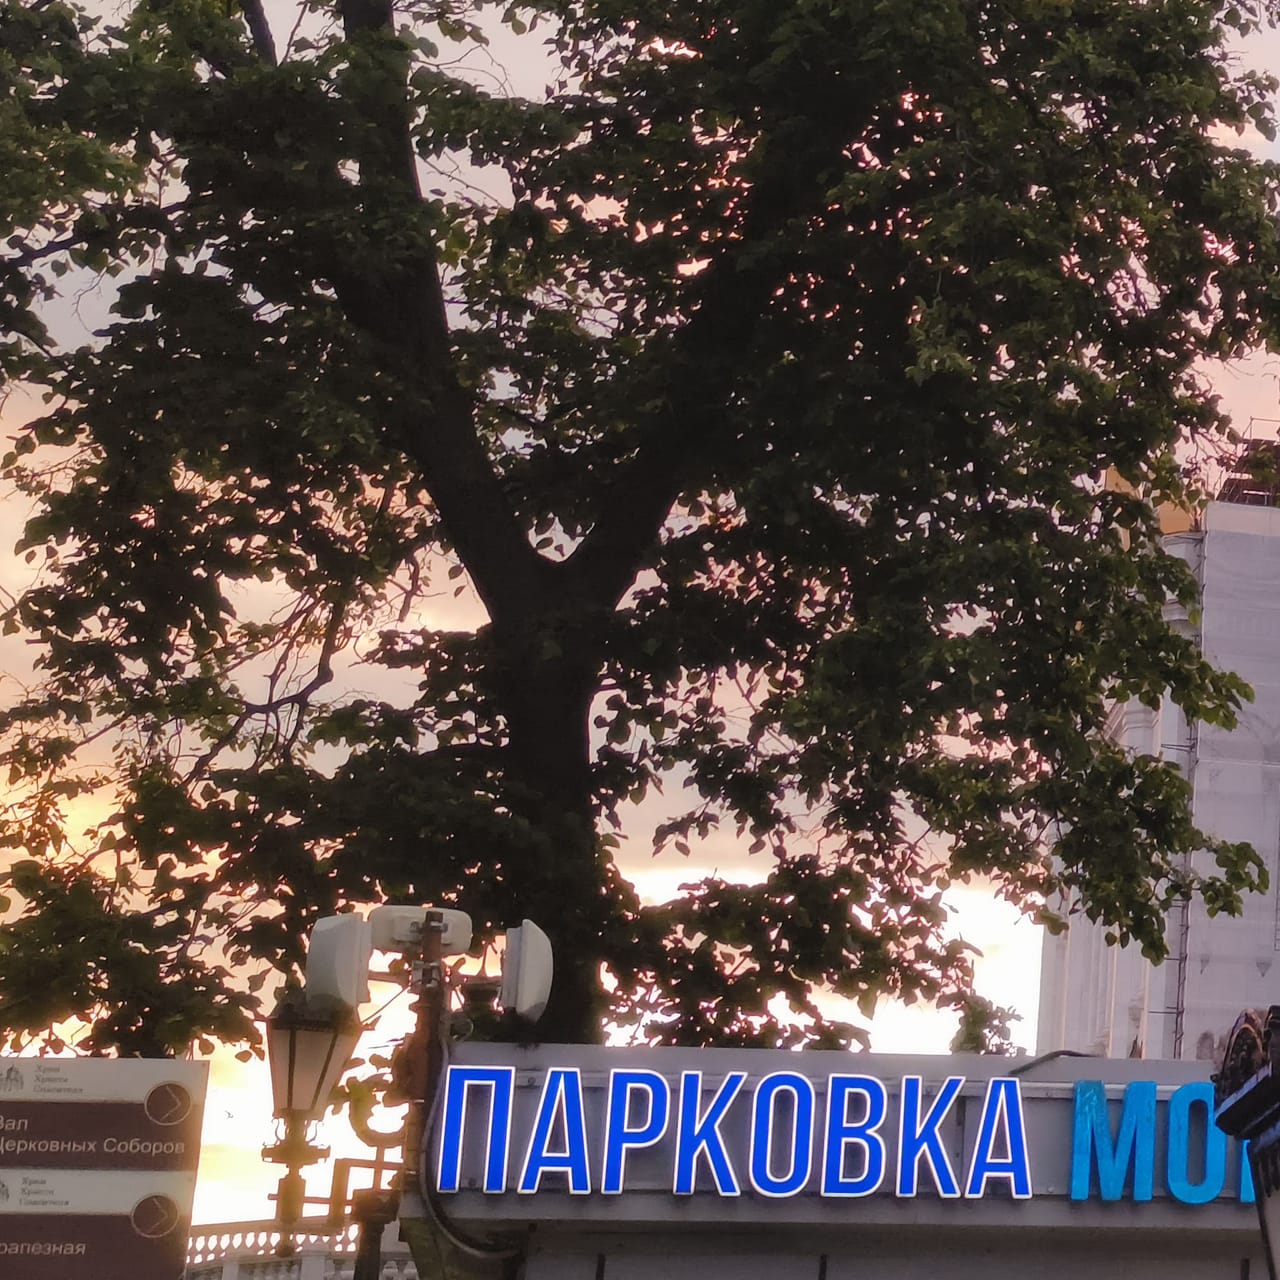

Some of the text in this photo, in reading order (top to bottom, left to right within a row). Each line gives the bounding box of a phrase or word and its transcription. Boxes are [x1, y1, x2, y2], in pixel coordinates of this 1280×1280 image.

[103, 1137, 185, 1156] Соборов
[436, 1065, 1256, 1205] ПАРКОВКА МО
